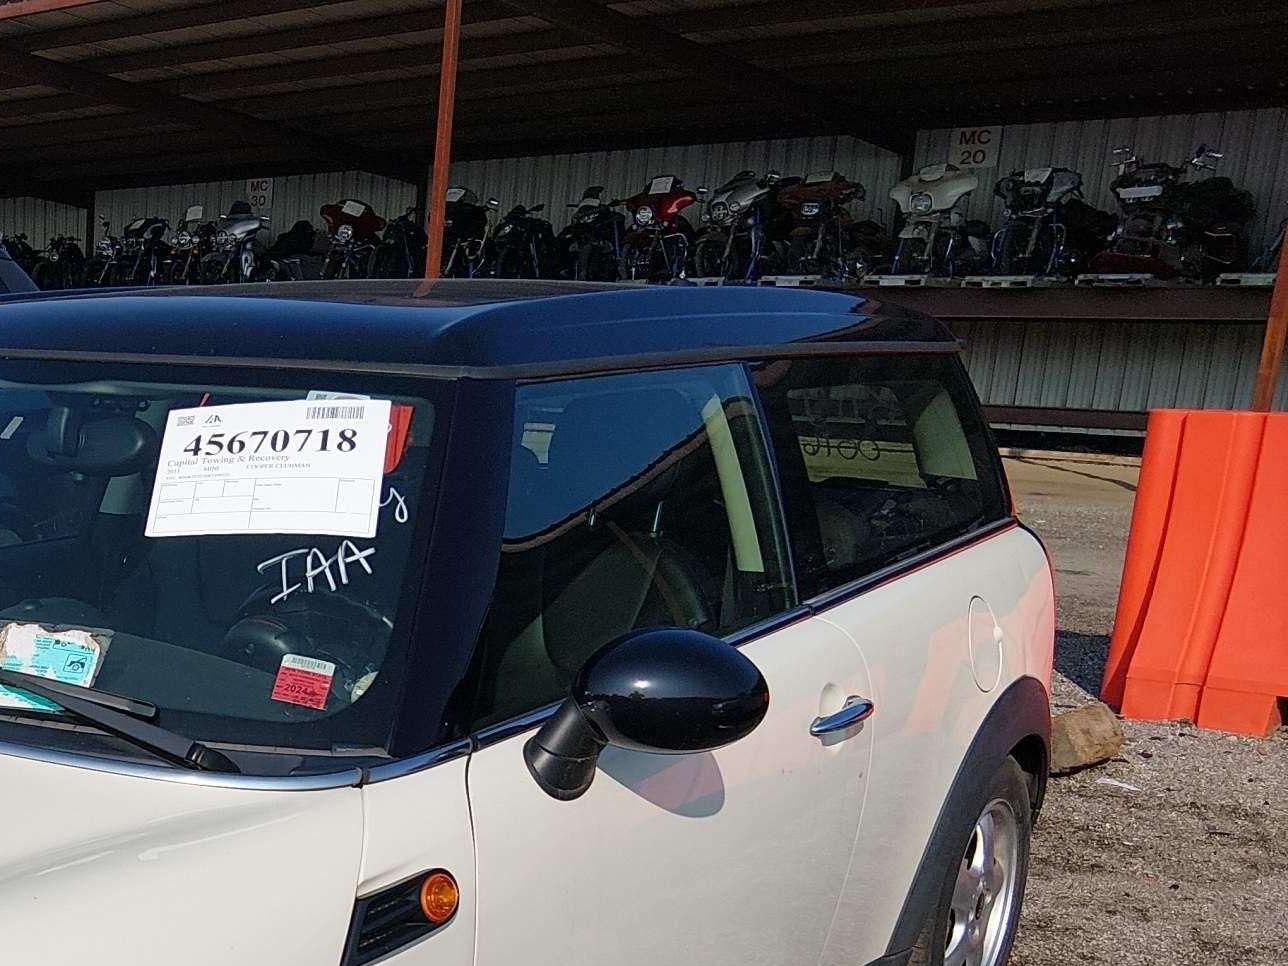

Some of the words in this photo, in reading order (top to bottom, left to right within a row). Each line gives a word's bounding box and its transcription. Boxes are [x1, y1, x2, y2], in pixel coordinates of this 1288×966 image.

[959, 130, 992, 145] MC
[959, 149, 986, 165] 20
[250, 180, 268, 192] MC
[250, 195, 266, 207] 30
[183, 428, 358, 457] 45670718
[167, 458, 199, 468] Capital
[201, 455, 234, 465] Towing
[237, 455, 246, 463] &
[248, 453, 290, 463] Recovery
[257, 539, 376, 605] IAA
[284, 682, 309, 695] 2024
